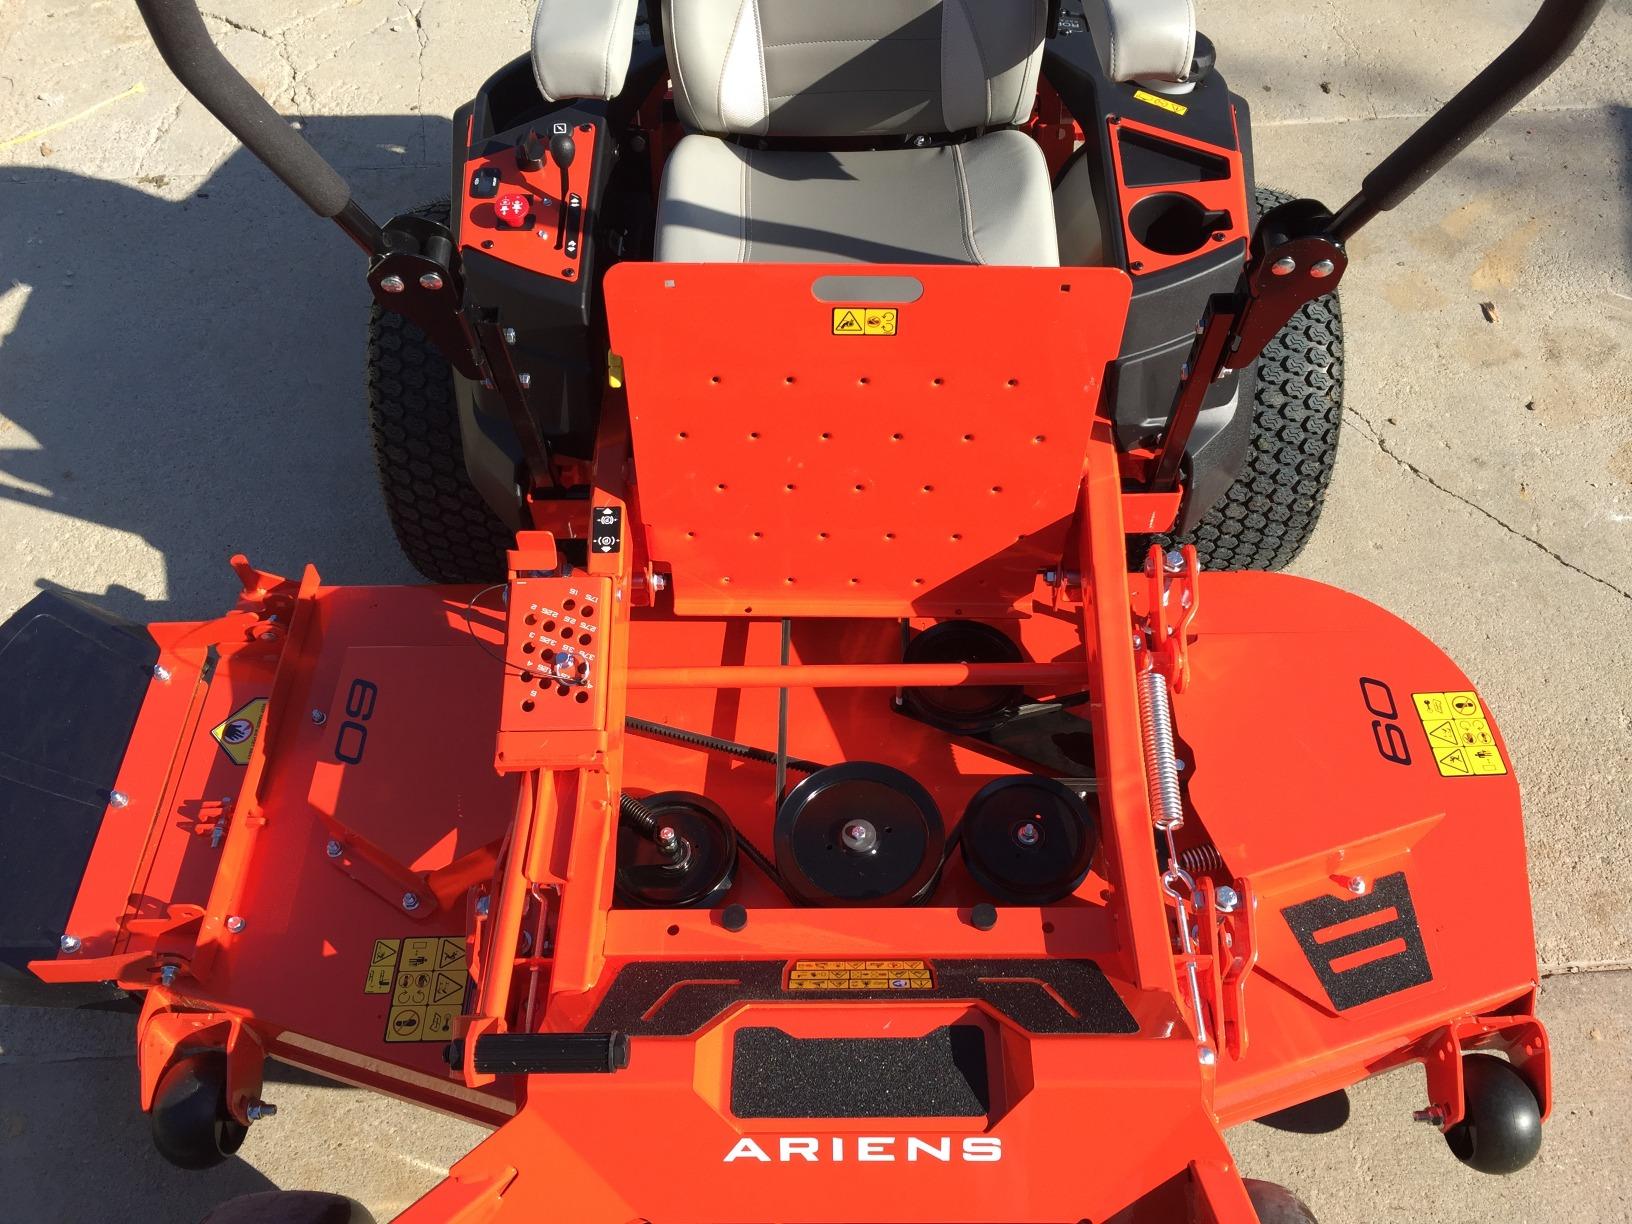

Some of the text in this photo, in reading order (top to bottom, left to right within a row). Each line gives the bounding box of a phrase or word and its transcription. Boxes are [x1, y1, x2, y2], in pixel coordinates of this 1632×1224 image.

[335, 678, 378, 765] 60
[1359, 677, 1412, 765] 60
[722, 1136, 1002, 1162] ARIENS
